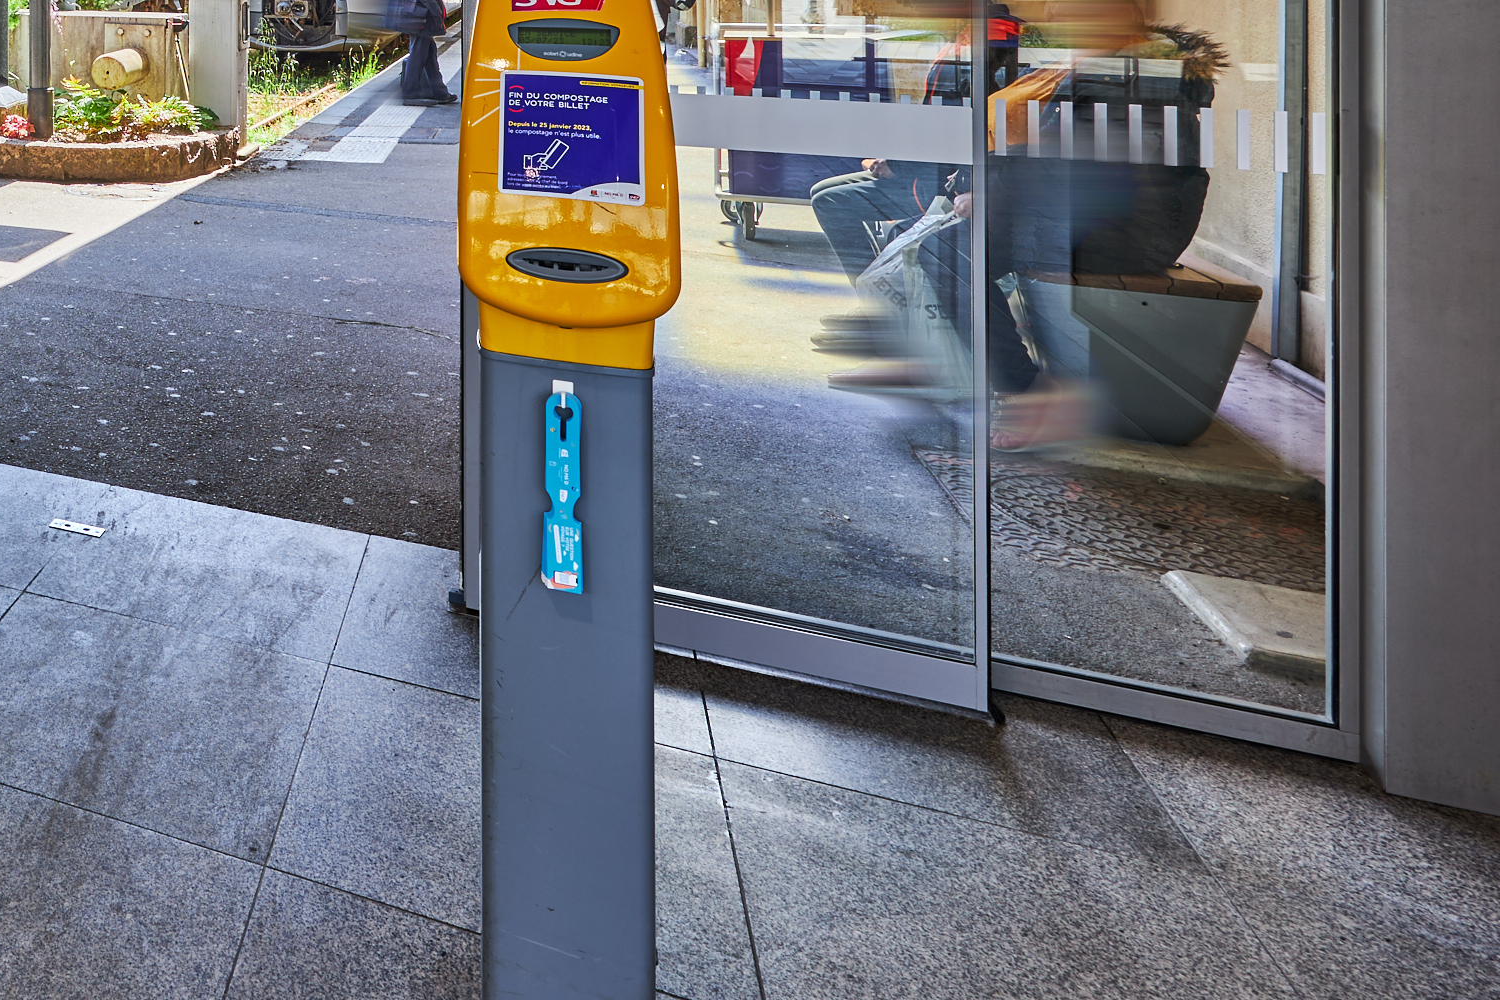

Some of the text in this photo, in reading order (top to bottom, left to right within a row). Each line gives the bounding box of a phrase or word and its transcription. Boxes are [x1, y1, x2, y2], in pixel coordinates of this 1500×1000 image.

[543, 93, 609, 104] COMPOSTAGE
[524, 100, 555, 108] VOTRE
[558, 101, 590, 110] BILLET
[508, 120, 530, 128] Depuis
[573, 124, 592, 132] 2023,
[515, 129, 553, 137] compostage
